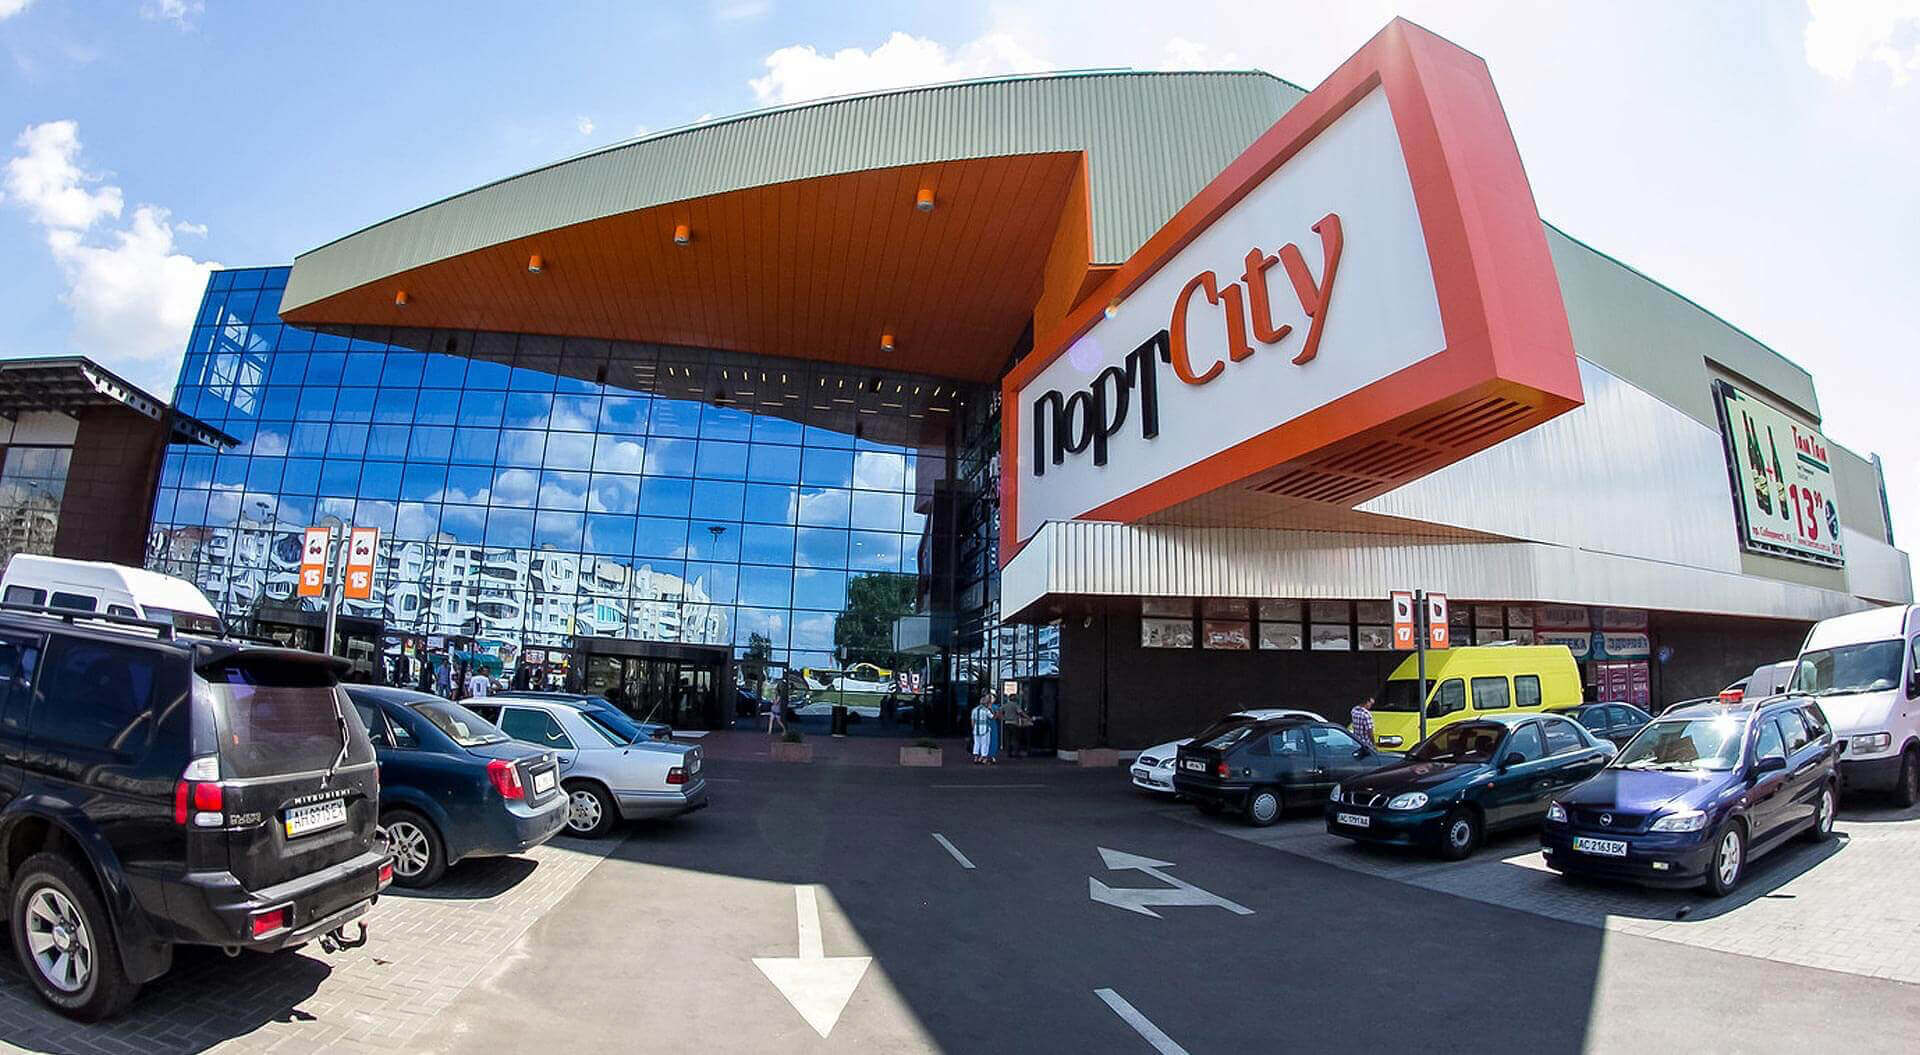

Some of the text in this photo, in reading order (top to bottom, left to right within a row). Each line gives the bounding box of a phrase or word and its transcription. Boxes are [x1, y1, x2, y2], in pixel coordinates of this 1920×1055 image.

[304, 569, 320, 587] 15
[351, 571, 369, 589] 15
[294, 789, 351, 805] MITSUBISHI
[1579, 839, 1590, 850] AC
[1611, 842, 1625, 855] BK
